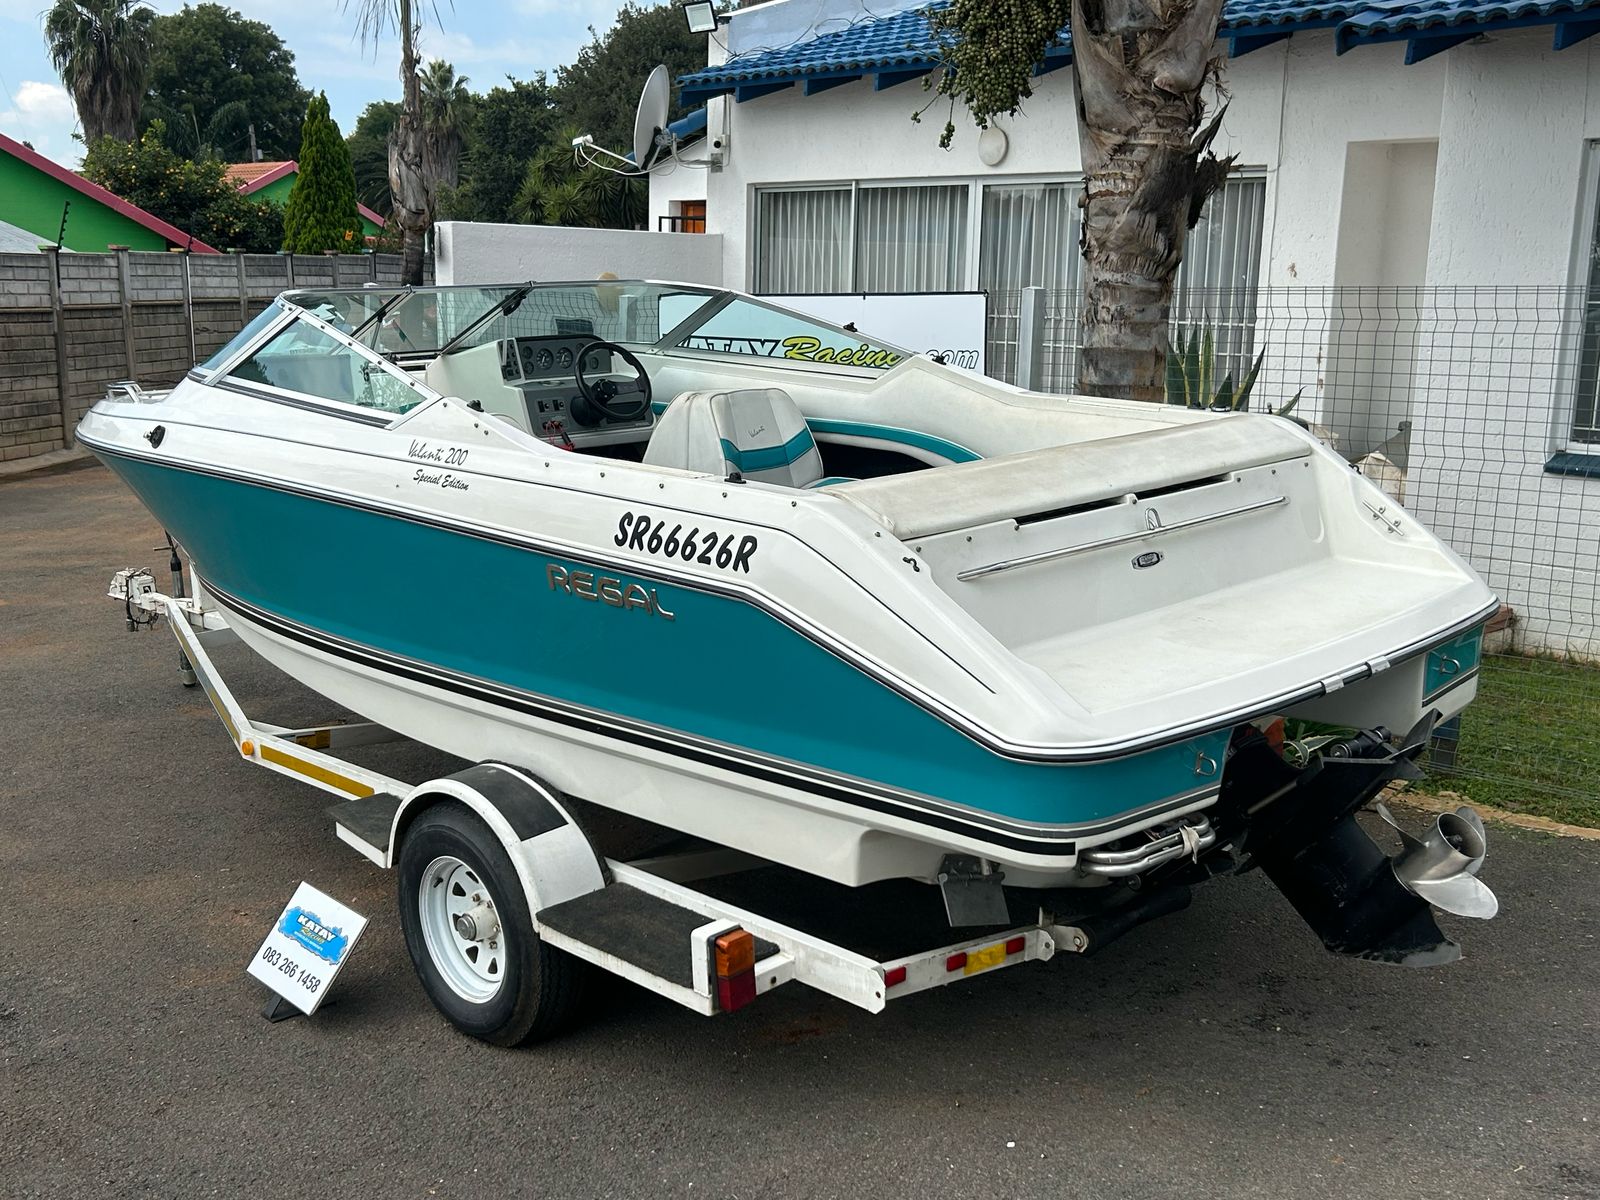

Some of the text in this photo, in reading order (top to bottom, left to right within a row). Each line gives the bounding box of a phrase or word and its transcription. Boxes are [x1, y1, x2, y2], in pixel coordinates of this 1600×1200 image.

[675, 334, 781, 358] ATAY
[444, 447, 469, 466] 200
[413, 468, 469, 491] Special Edition
[614, 511, 758, 574] SR66626R
[546, 563, 675, 621] REGAL
[297, 914, 338, 942] KATAY
[262, 946, 321, 994] 083 266 1458
